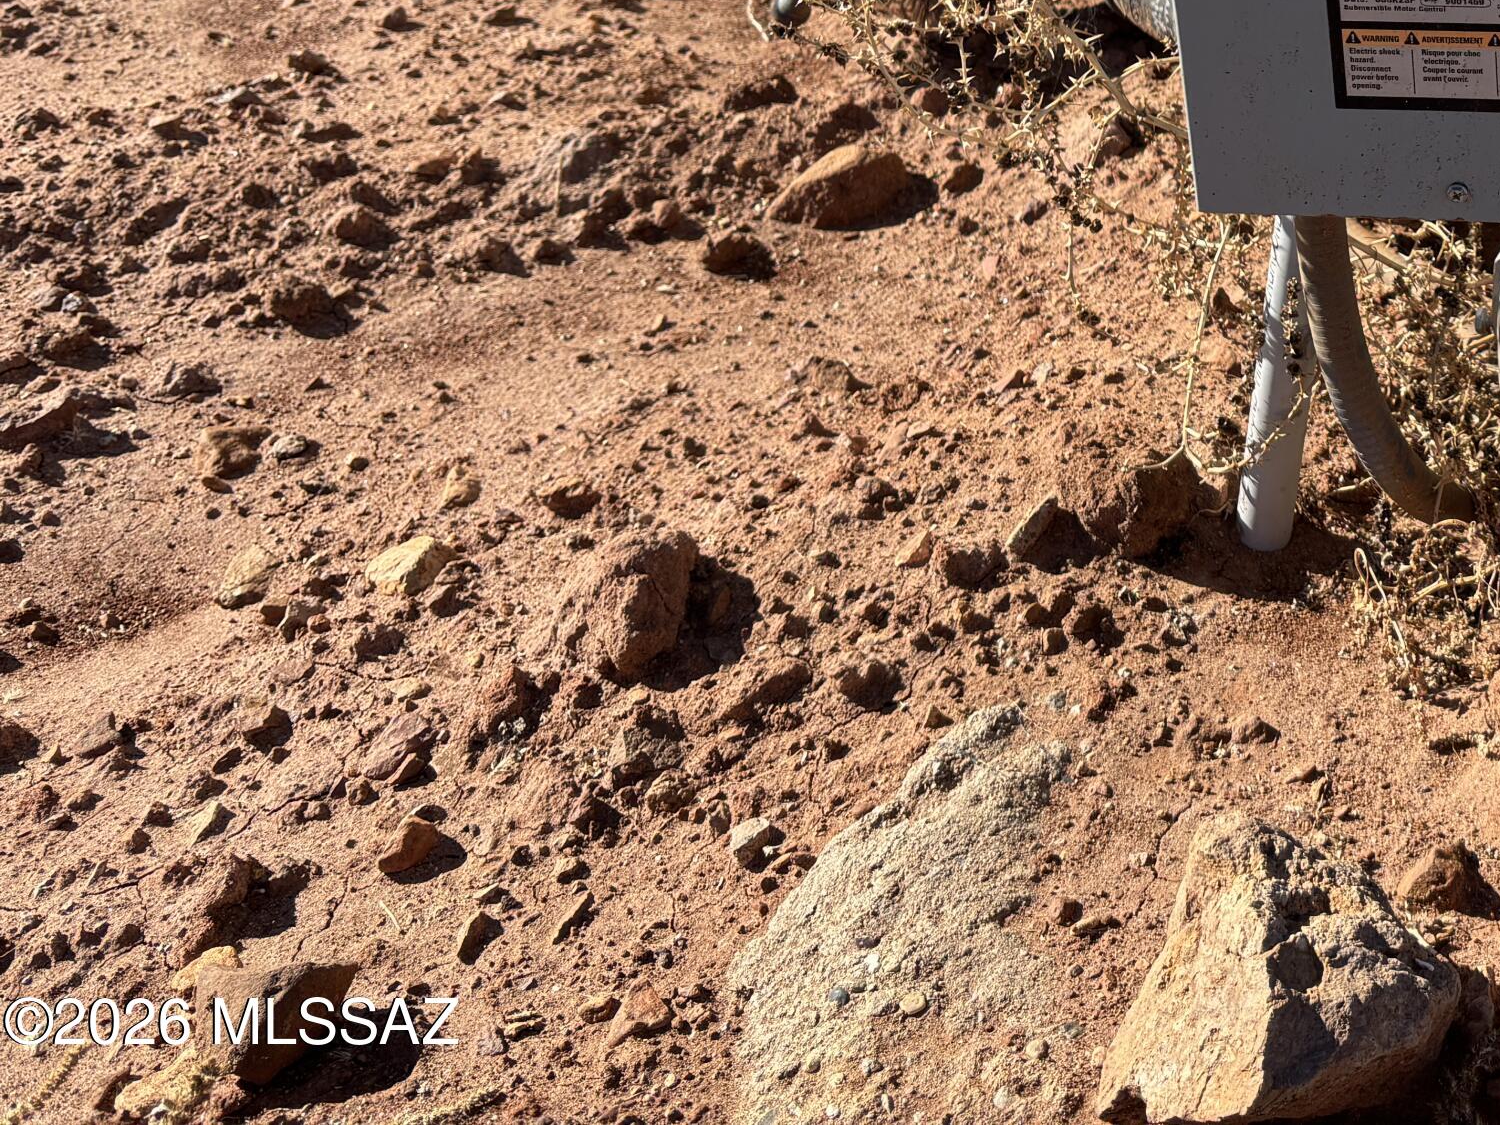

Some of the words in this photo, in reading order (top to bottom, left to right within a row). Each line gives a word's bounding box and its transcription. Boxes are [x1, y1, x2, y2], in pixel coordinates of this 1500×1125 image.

[1344, 4, 1392, 12] Submersible
[1393, 5, 1416, 13] Motor
[1362, 35, 1400, 43] WARNING
[1422, 37, 1484, 45] ADVERTISSEMENT
[1422, 49, 1445, 59] Risque
[1446, 51, 1463, 59] pour
[1351, 65, 1392, 73] Disconnect
[1422, 67, 1447, 75] Couper
[1352, 75, 1376, 83] power
[1352, 83, 1383, 91] opening.
